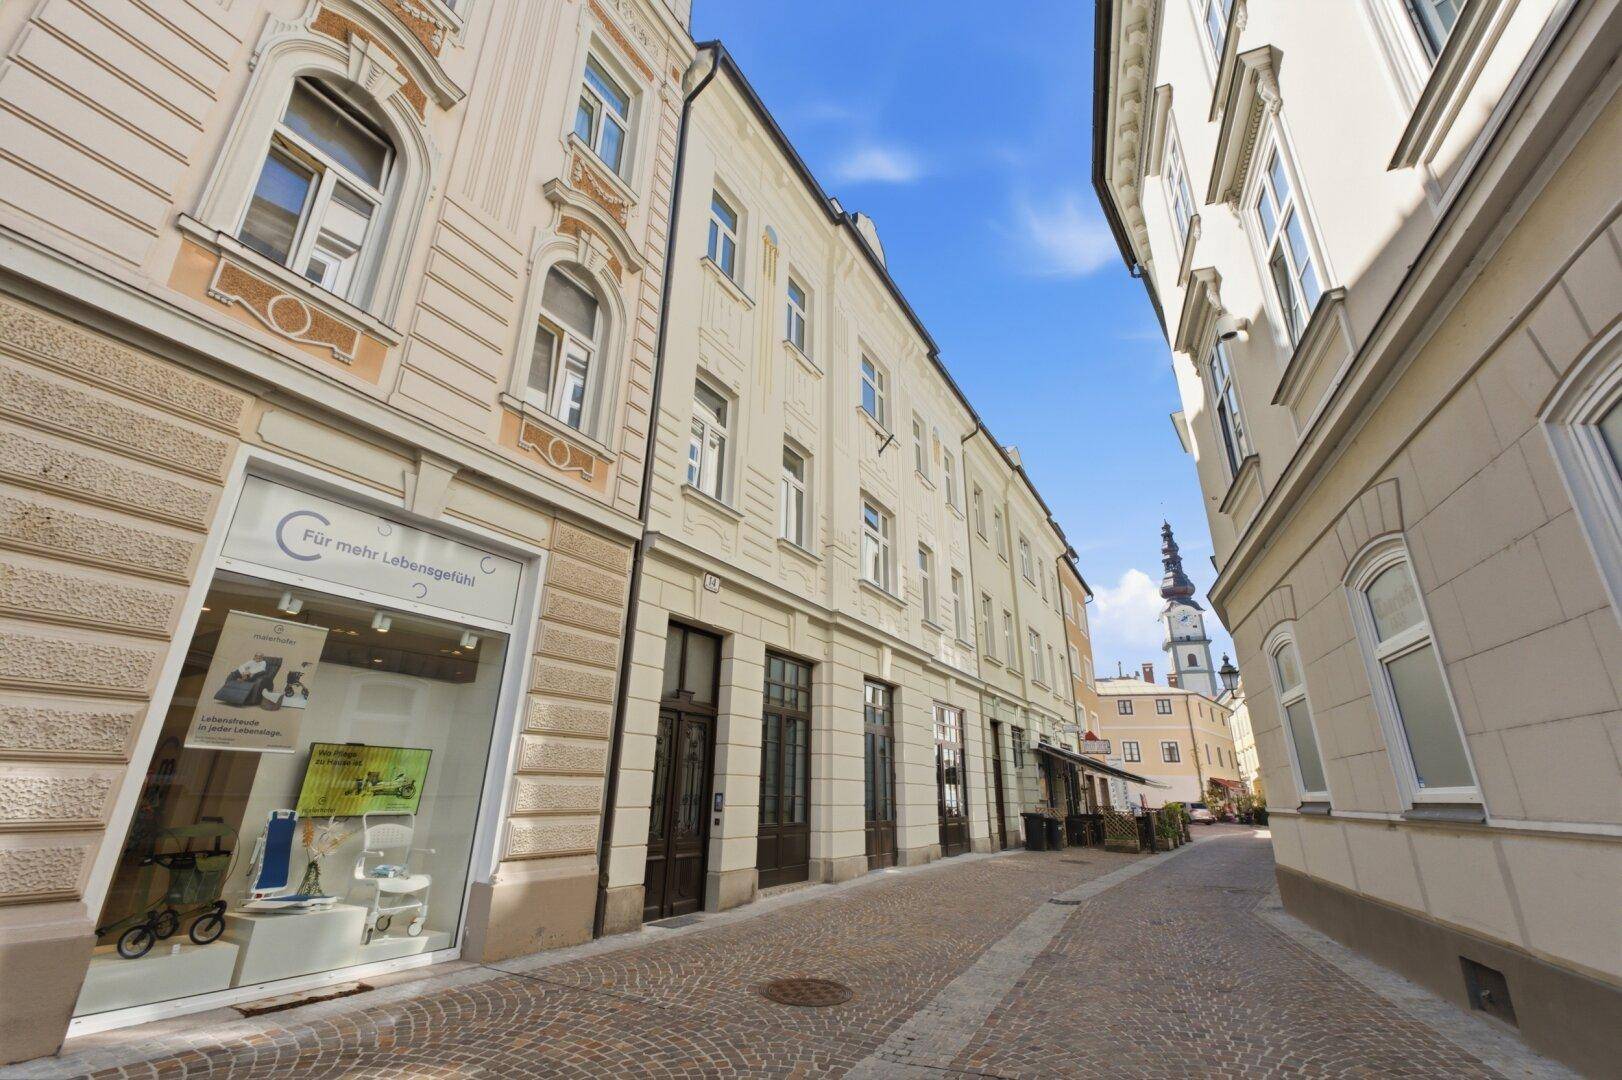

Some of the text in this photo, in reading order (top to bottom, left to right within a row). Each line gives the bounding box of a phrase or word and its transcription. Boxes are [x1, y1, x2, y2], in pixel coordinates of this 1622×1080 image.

[302, 529, 476, 587] Für mehr Lebensgefühl
[201, 715, 260, 726] Lebensfreude
[197, 723, 207, 731] in
[208, 725, 232, 733] jeder
